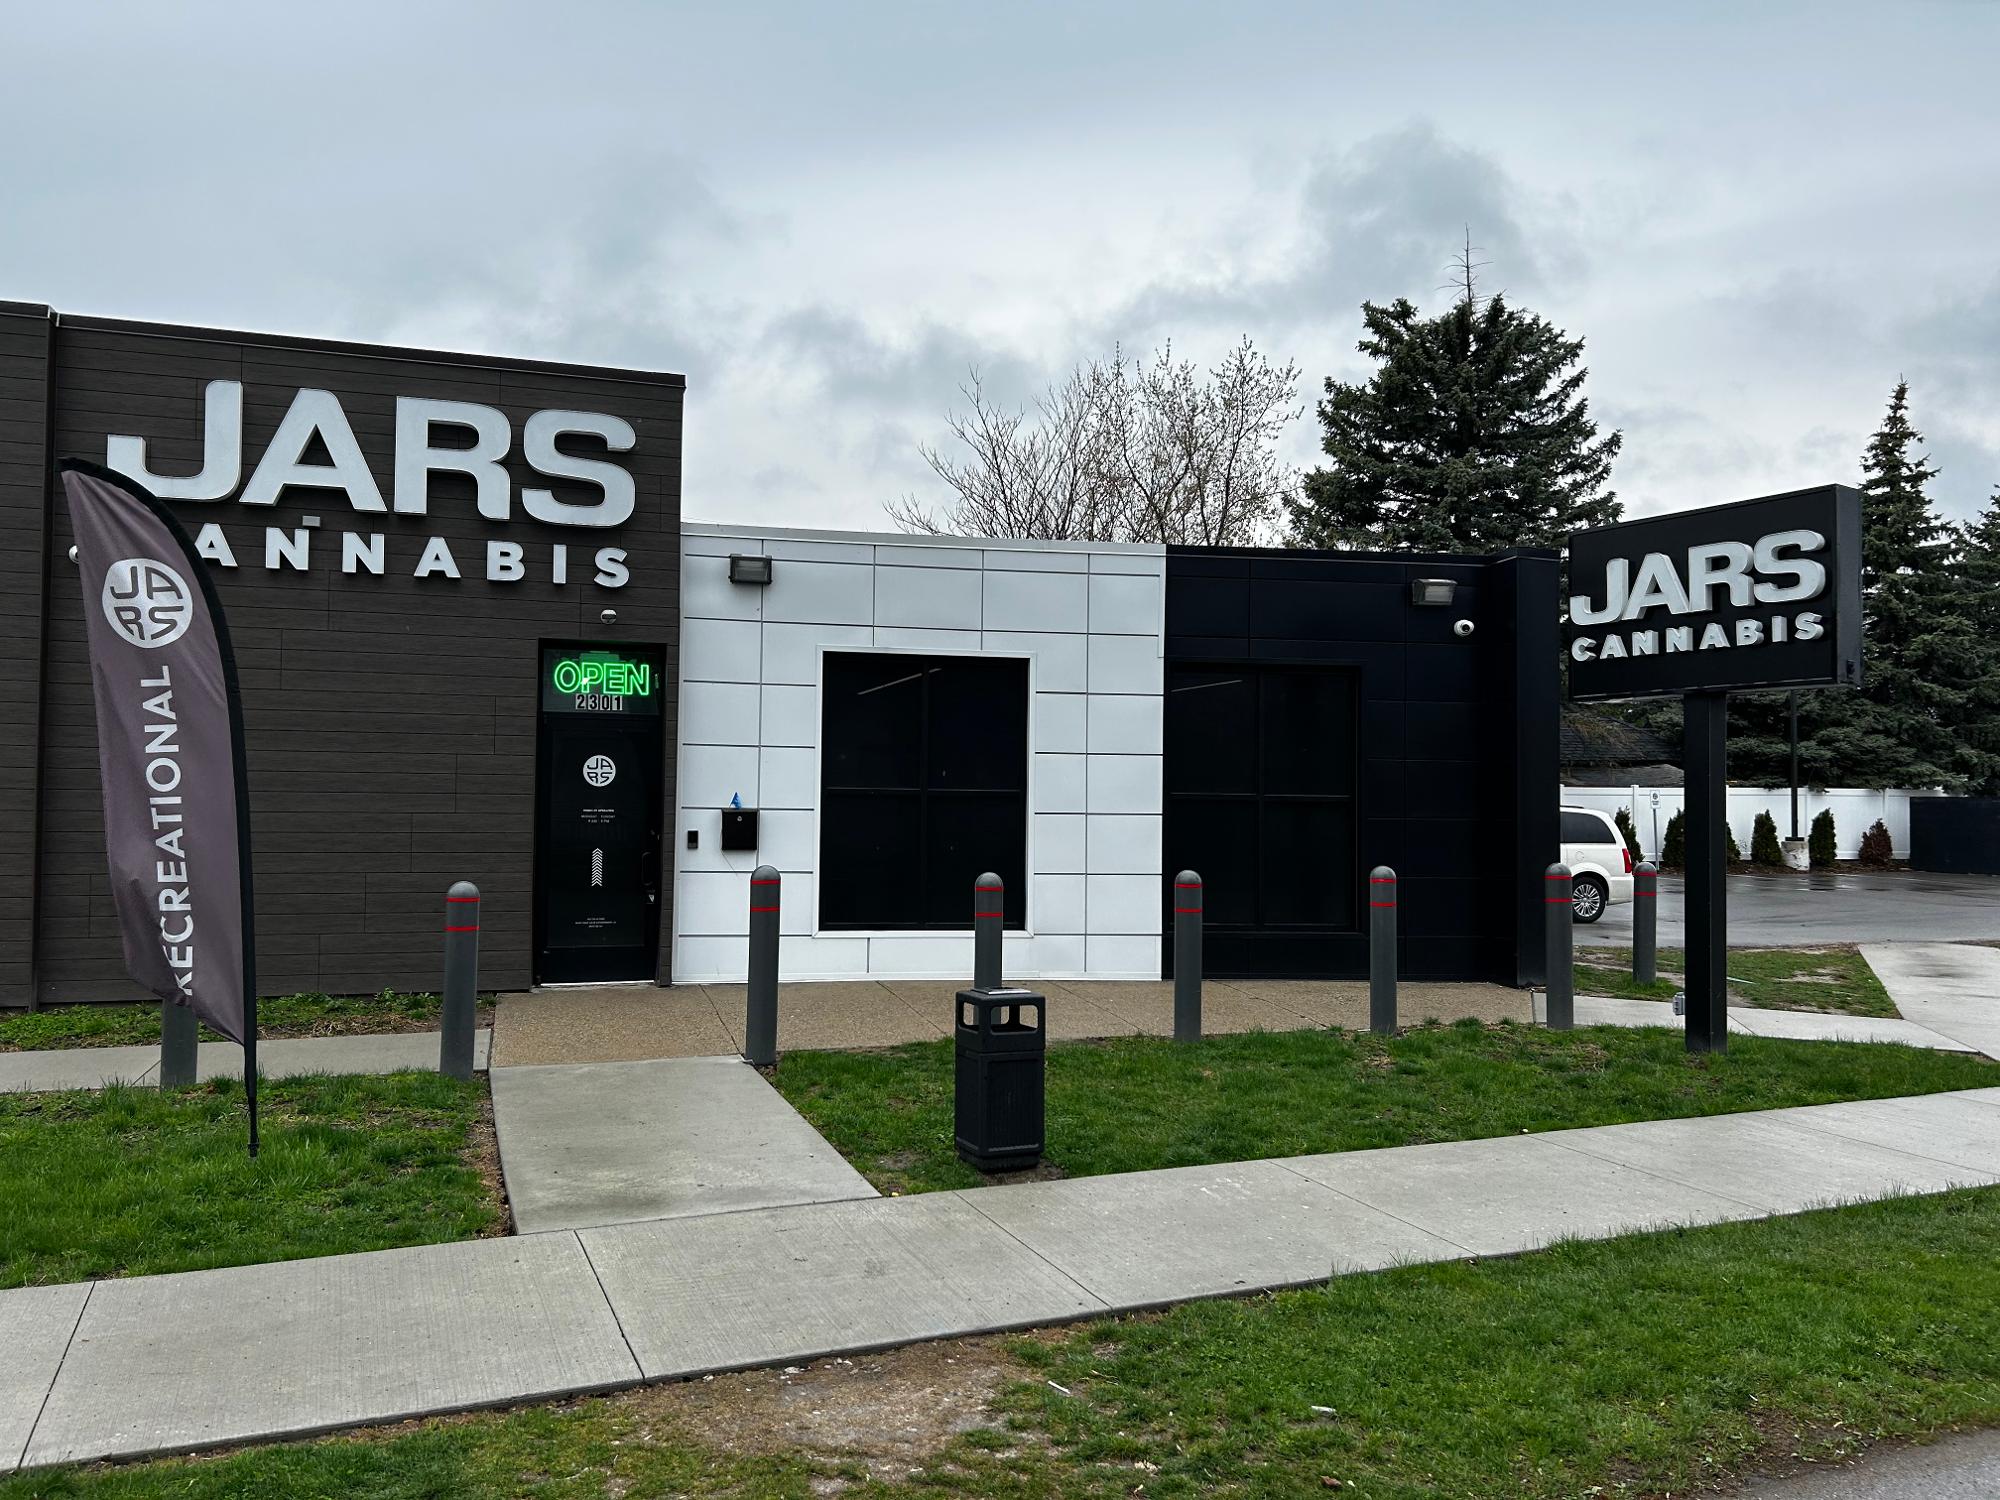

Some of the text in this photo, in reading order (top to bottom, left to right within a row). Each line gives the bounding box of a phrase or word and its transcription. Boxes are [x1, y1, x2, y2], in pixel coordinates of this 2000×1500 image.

[107, 379, 636, 528] JARS
[194, 522, 630, 588] ANNABIS
[1569, 529, 1826, 626] JARS
[1571, 611, 1825, 662] CANNABIS
[554, 660, 650, 696] OPEN
[576, 694, 623, 711] 2301
